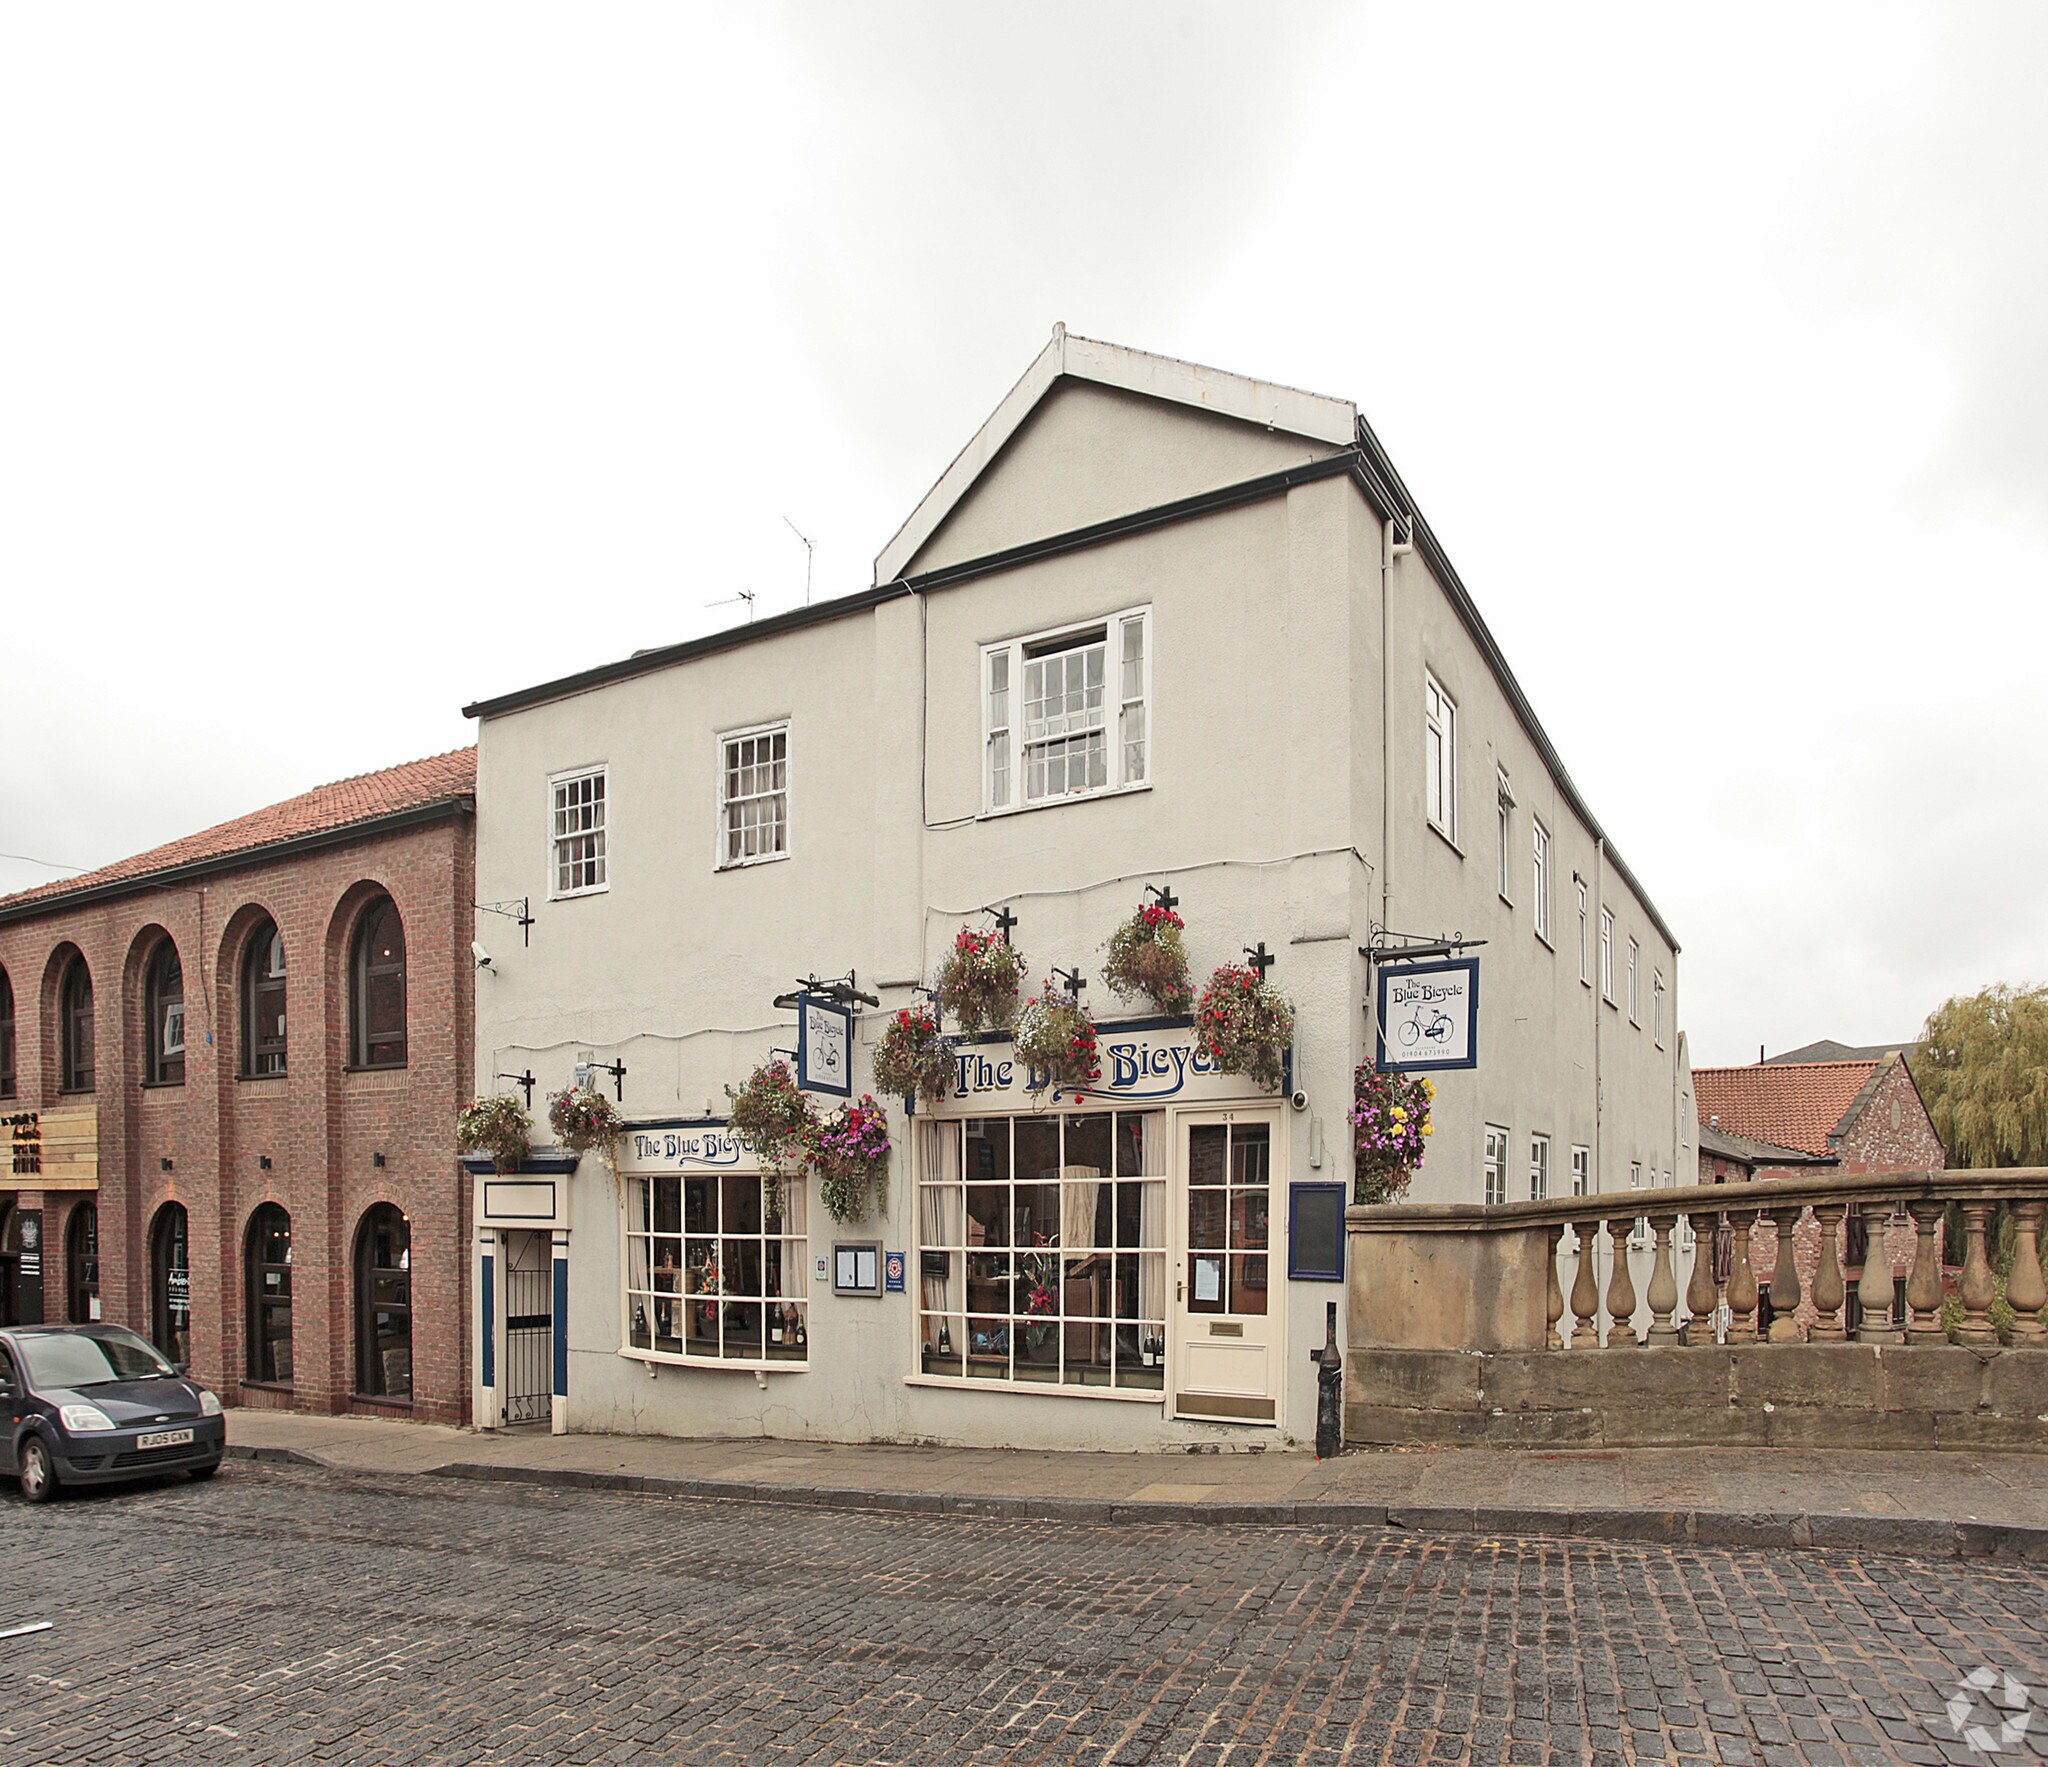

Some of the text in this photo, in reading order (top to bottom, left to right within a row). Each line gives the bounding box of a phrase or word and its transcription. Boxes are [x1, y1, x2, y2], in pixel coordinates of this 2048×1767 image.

[1405, 978, 1420, 989] The
[1393, 984, 1463, 1004] Blue Bicycle
[809, 1016, 844, 1037] Blue Bicycle
[953, 1053, 1014, 1098] The
[1107, 1041, 1224, 1096] Bicyc
[1222, 1113, 1235, 1121] 34
[634, 1135, 661, 1159] The
[664, 1134, 700, 1159] Blue
